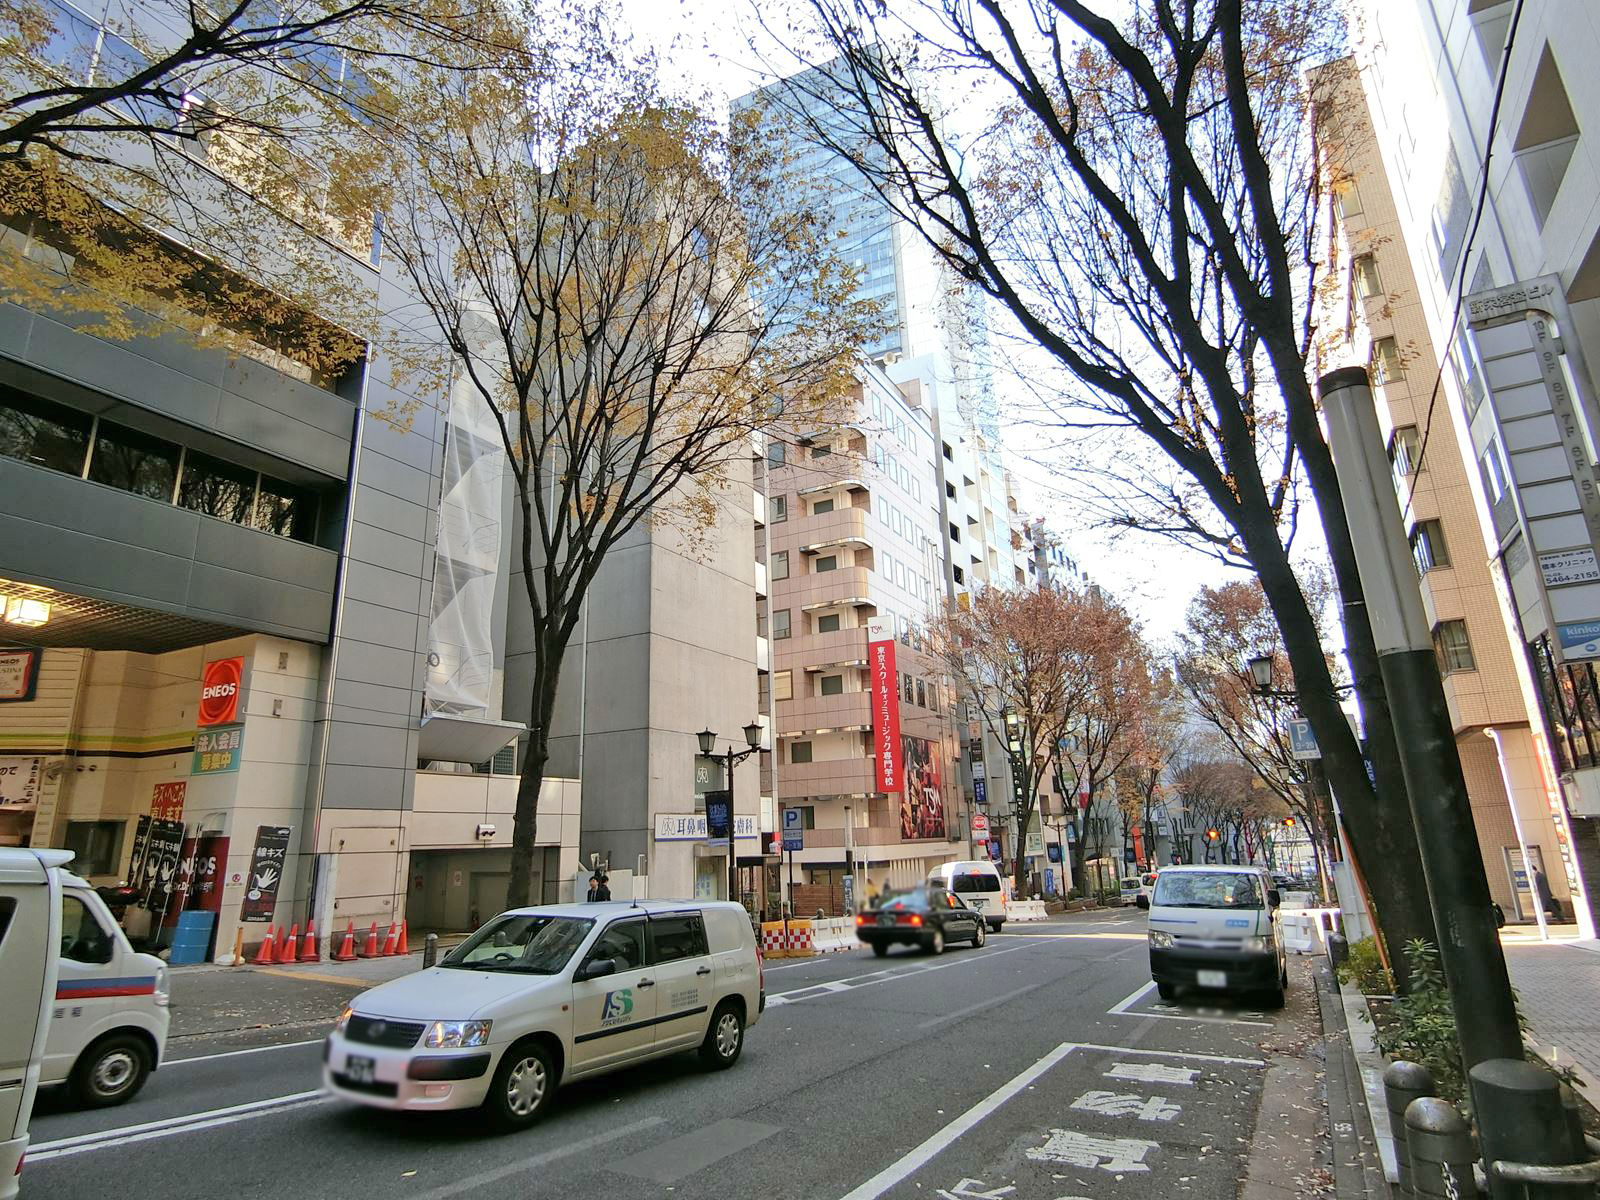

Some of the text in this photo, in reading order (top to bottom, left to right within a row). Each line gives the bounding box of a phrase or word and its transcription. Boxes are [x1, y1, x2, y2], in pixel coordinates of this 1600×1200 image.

[202, 683, 236, 700] ENEOS
[877, 646, 893, 786] 東京スクールオブミュージック専門学校
[1296, 723, 1309, 741] P
[198, 730, 240, 753] 法人会員
[923, 788, 941, 815] TSM
[786, 811, 798, 827] P
[256, 846, 285, 858] 線キズ
